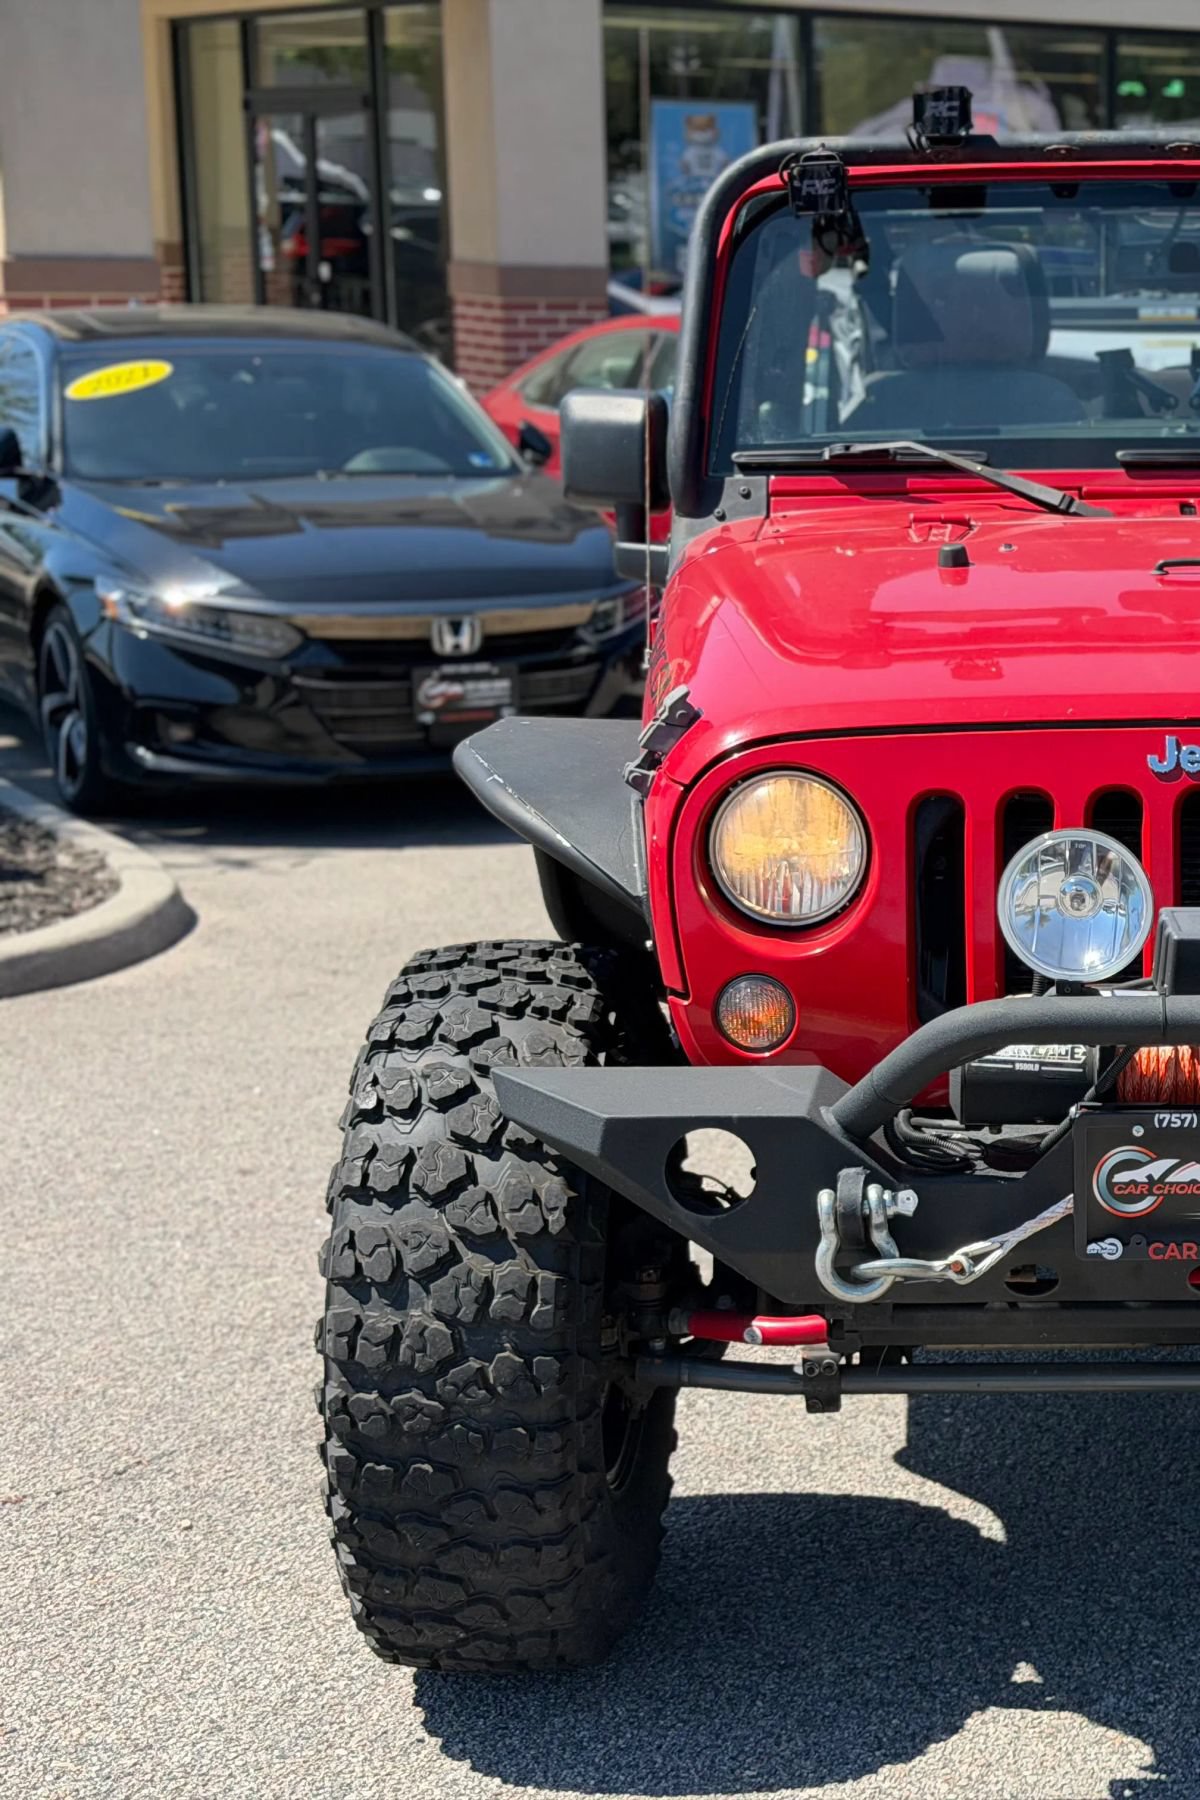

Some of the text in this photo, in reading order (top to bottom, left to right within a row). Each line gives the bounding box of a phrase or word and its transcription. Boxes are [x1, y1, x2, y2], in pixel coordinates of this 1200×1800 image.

[1154, 1113, 1198, 1128] (757)
[1113, 1183, 1150, 1195] CAR
[1148, 1242, 1198, 1260] CAR
